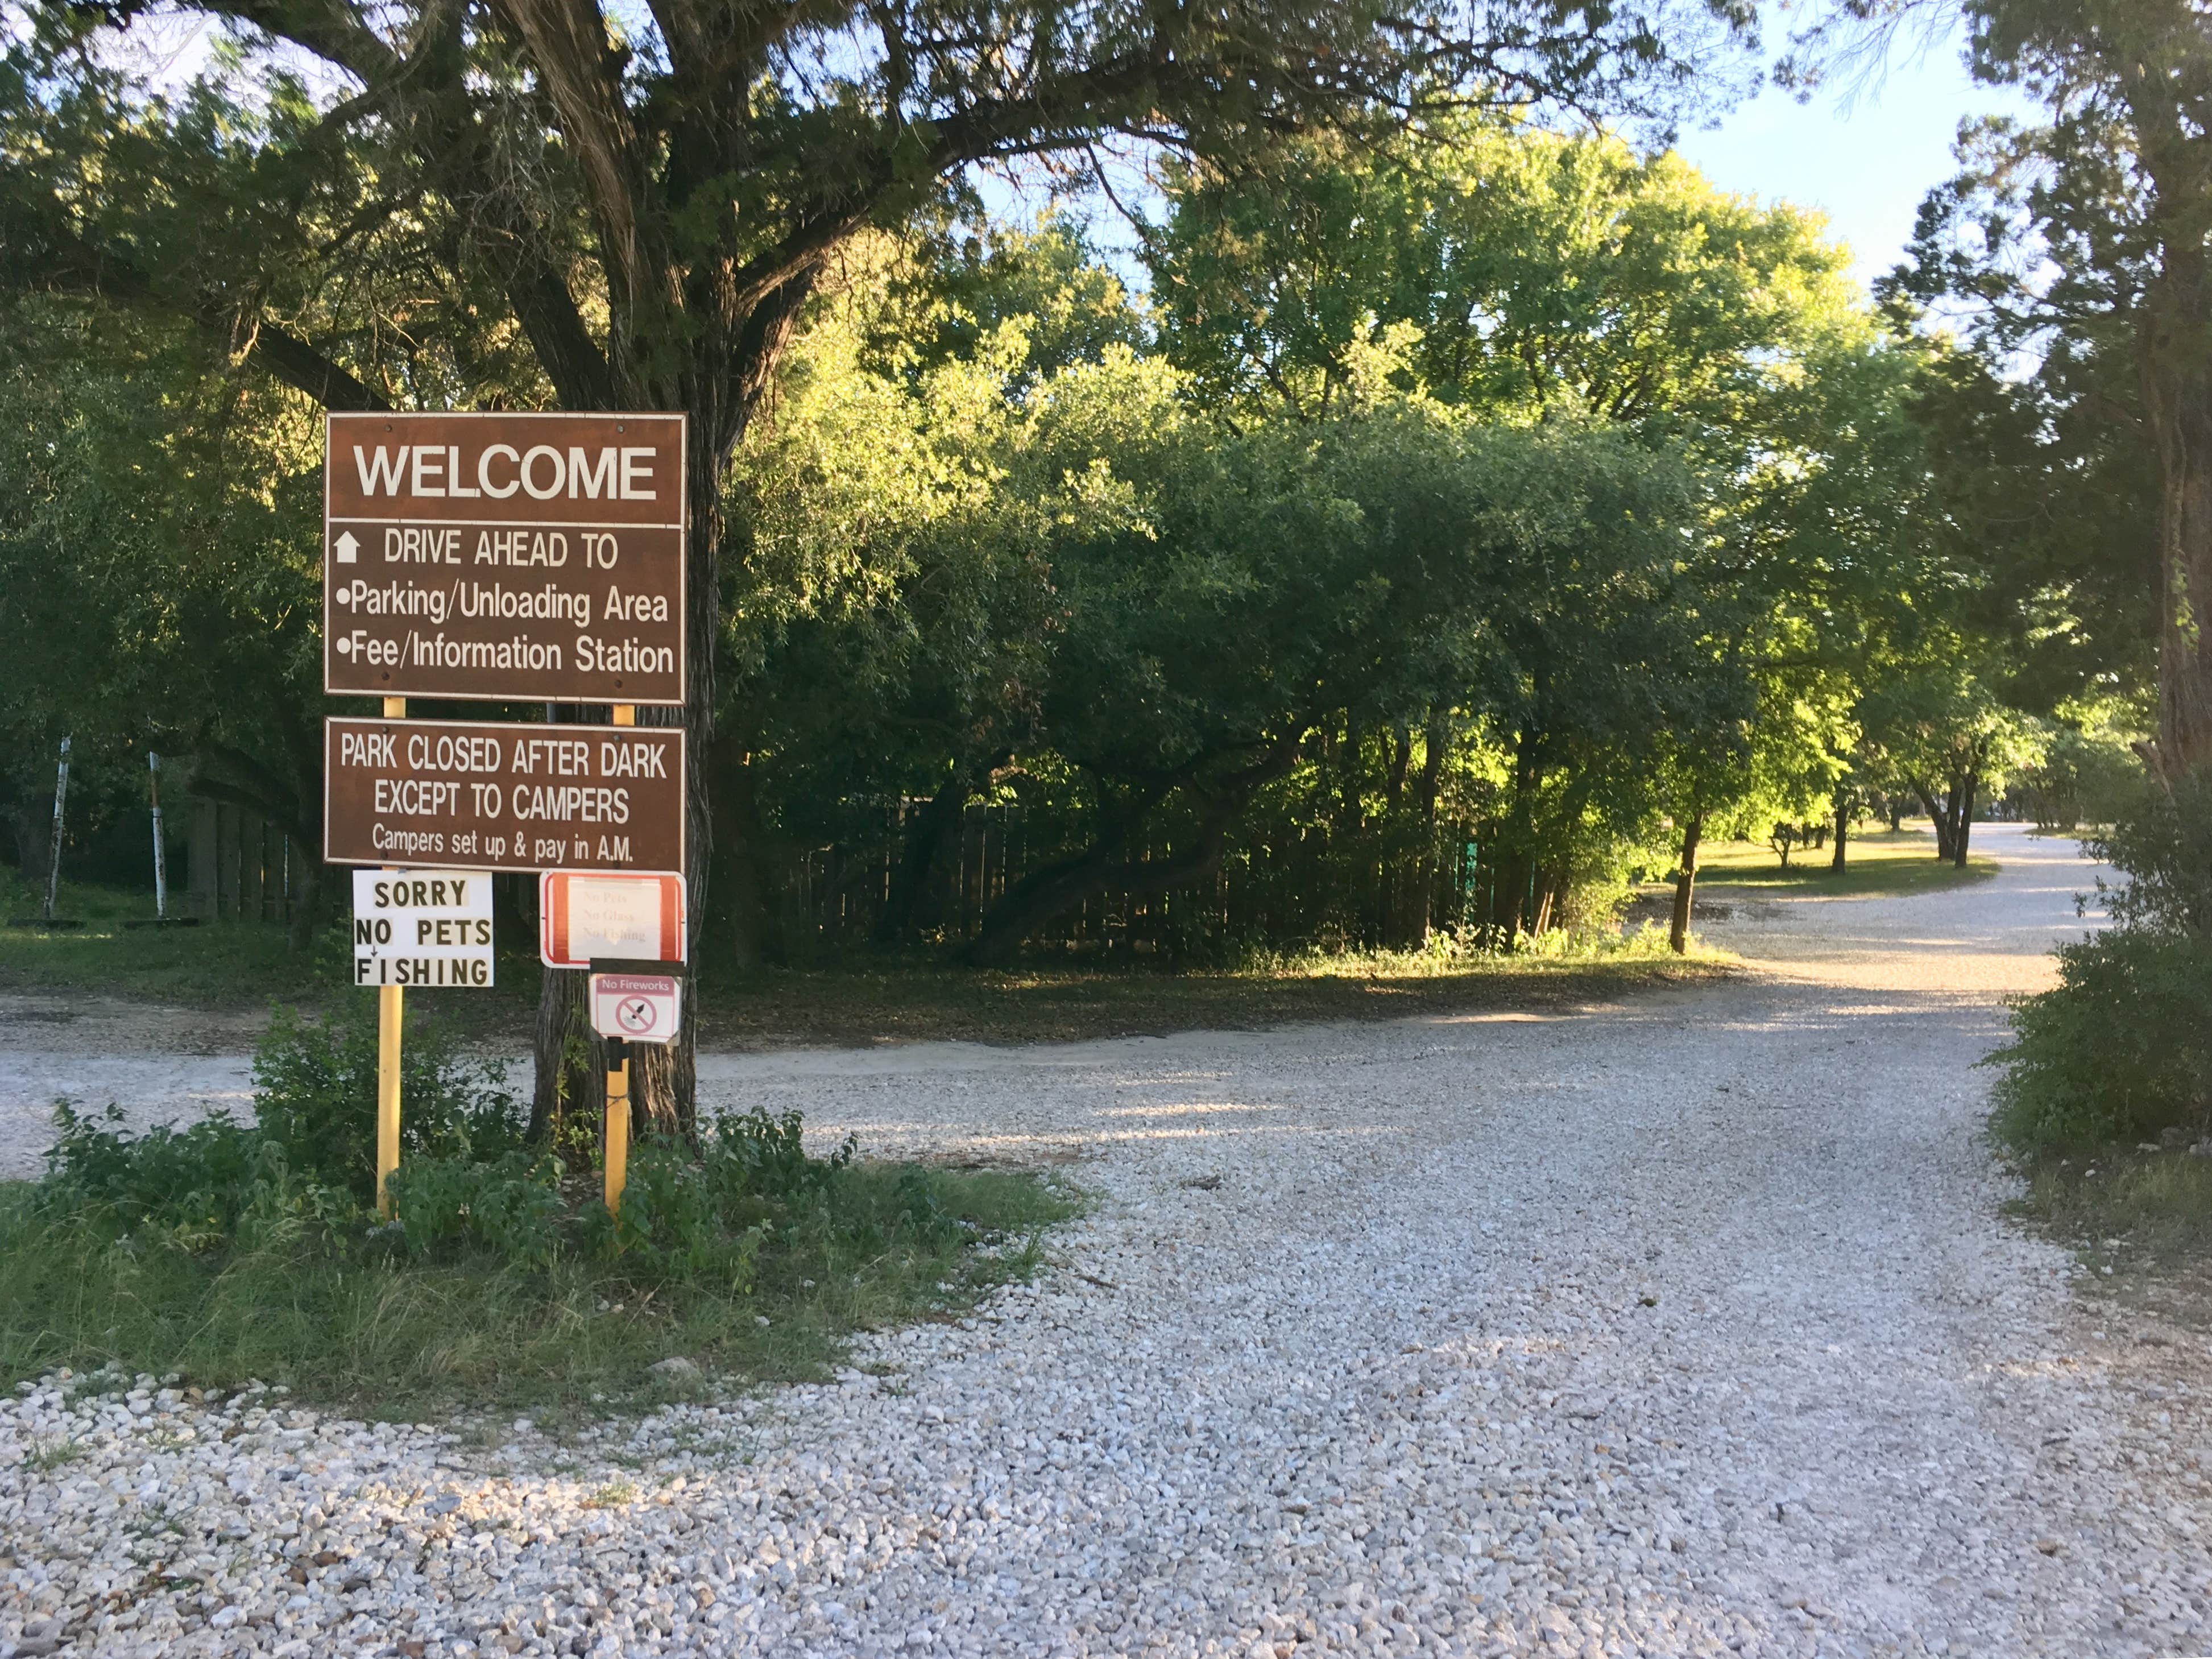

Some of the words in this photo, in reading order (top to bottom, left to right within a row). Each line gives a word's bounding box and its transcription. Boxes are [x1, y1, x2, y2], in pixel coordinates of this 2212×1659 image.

[353, 444, 656, 500] WELCOME
[385, 528, 461, 564] DRIVE
[474, 531, 568, 567] AHEAD
[581, 533, 618, 569] TO
[351, 578, 590, 628] Parking/Unloading
[604, 585, 668, 622] Area
[351, 630, 561, 670] Fee/Information
[575, 635, 673, 673] Station
[341, 733, 397, 768] PARK
[408, 735, 501, 772] CLOSED
[511, 739, 589, 776] AFTER
[601, 742, 667, 779] DARK
[375, 779, 461, 816] EXCEPT
[470, 783, 502, 818] TO
[512, 784, 629, 824] CAMPERS
[372, 822, 444, 856] Campers
[451, 830, 477, 854] set
[485, 837, 506, 861] up
[514, 831, 526, 857] &
[535, 839, 566, 864] pay
[574, 833, 589, 859] in
[597, 835, 633, 862] A.M.
[375, 880, 465, 908] SORRY
[357, 919, 391, 945] NO
[417, 920, 490, 945] PETS
[357, 958, 487, 984] FISHING
[602, 979, 618, 989] No
[620, 979, 669, 991] Fireworks
